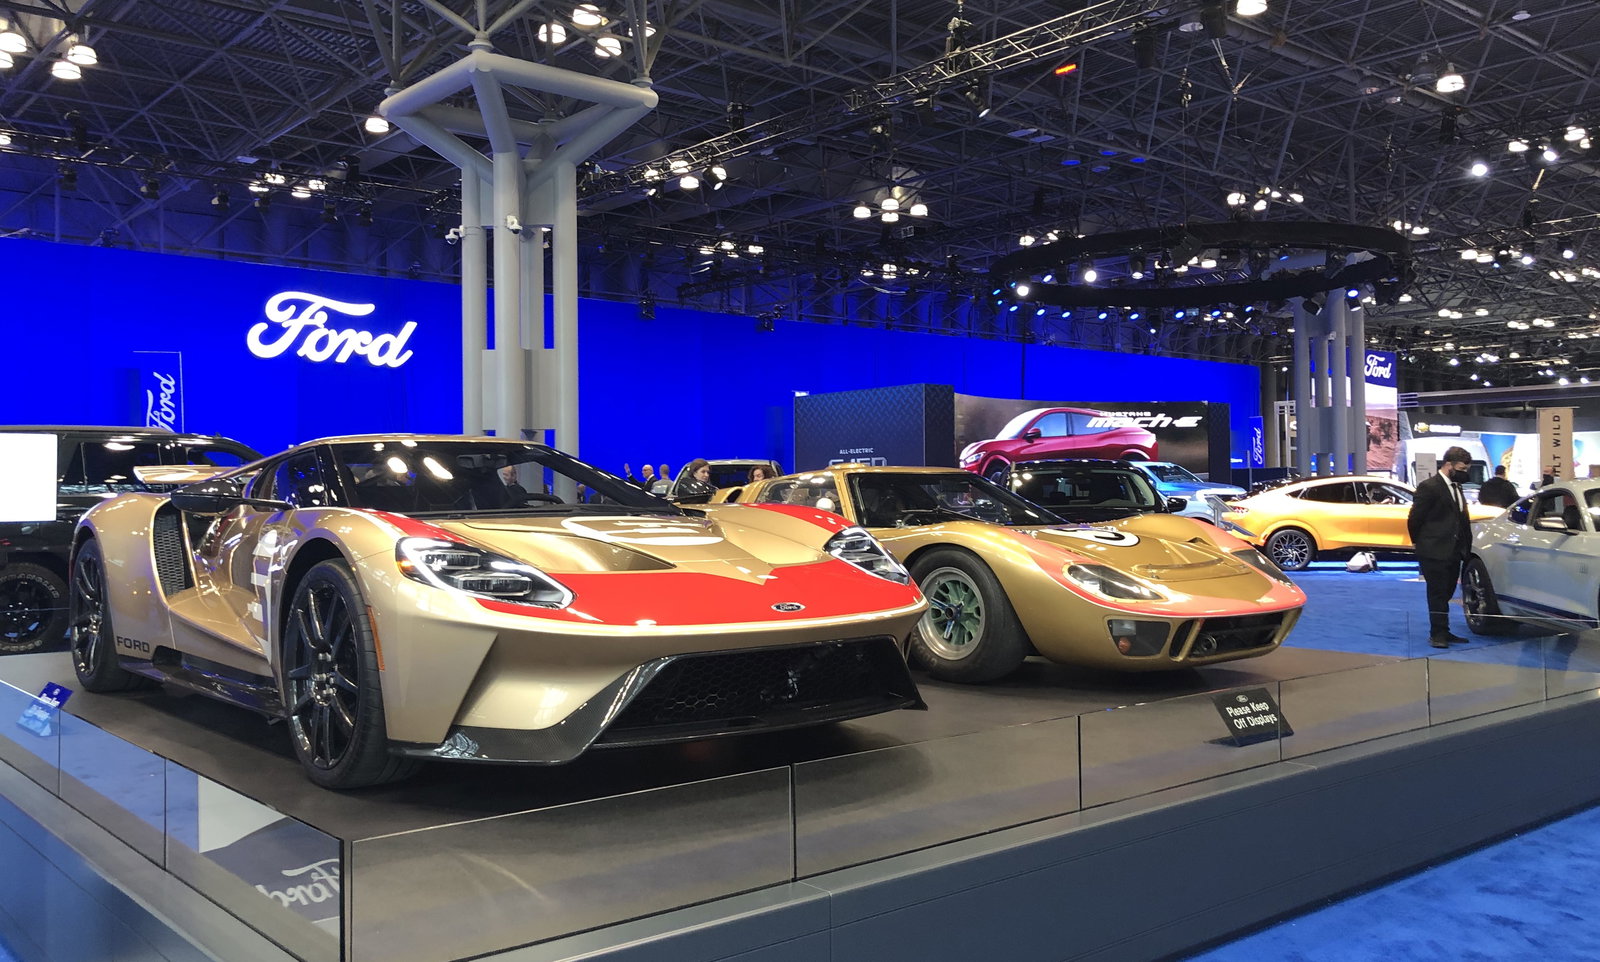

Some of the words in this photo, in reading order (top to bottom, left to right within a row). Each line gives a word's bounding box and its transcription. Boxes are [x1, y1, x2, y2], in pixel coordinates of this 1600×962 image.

[247, 291, 418, 368] Ford
[1363, 354, 1392, 379] Ford
[1552, 415, 1561, 448] WILD
[839, 447, 874, 455] ALL-ELECTRIC
[1252, 427, 1263, 465] Ford
[116, 635, 150, 653] FORD
[1226, 706, 1251, 717] Please
[1249, 702, 1270, 712] Keep
[1234, 718, 1248, 729] Off
[1246, 714, 1277, 726] Displays
